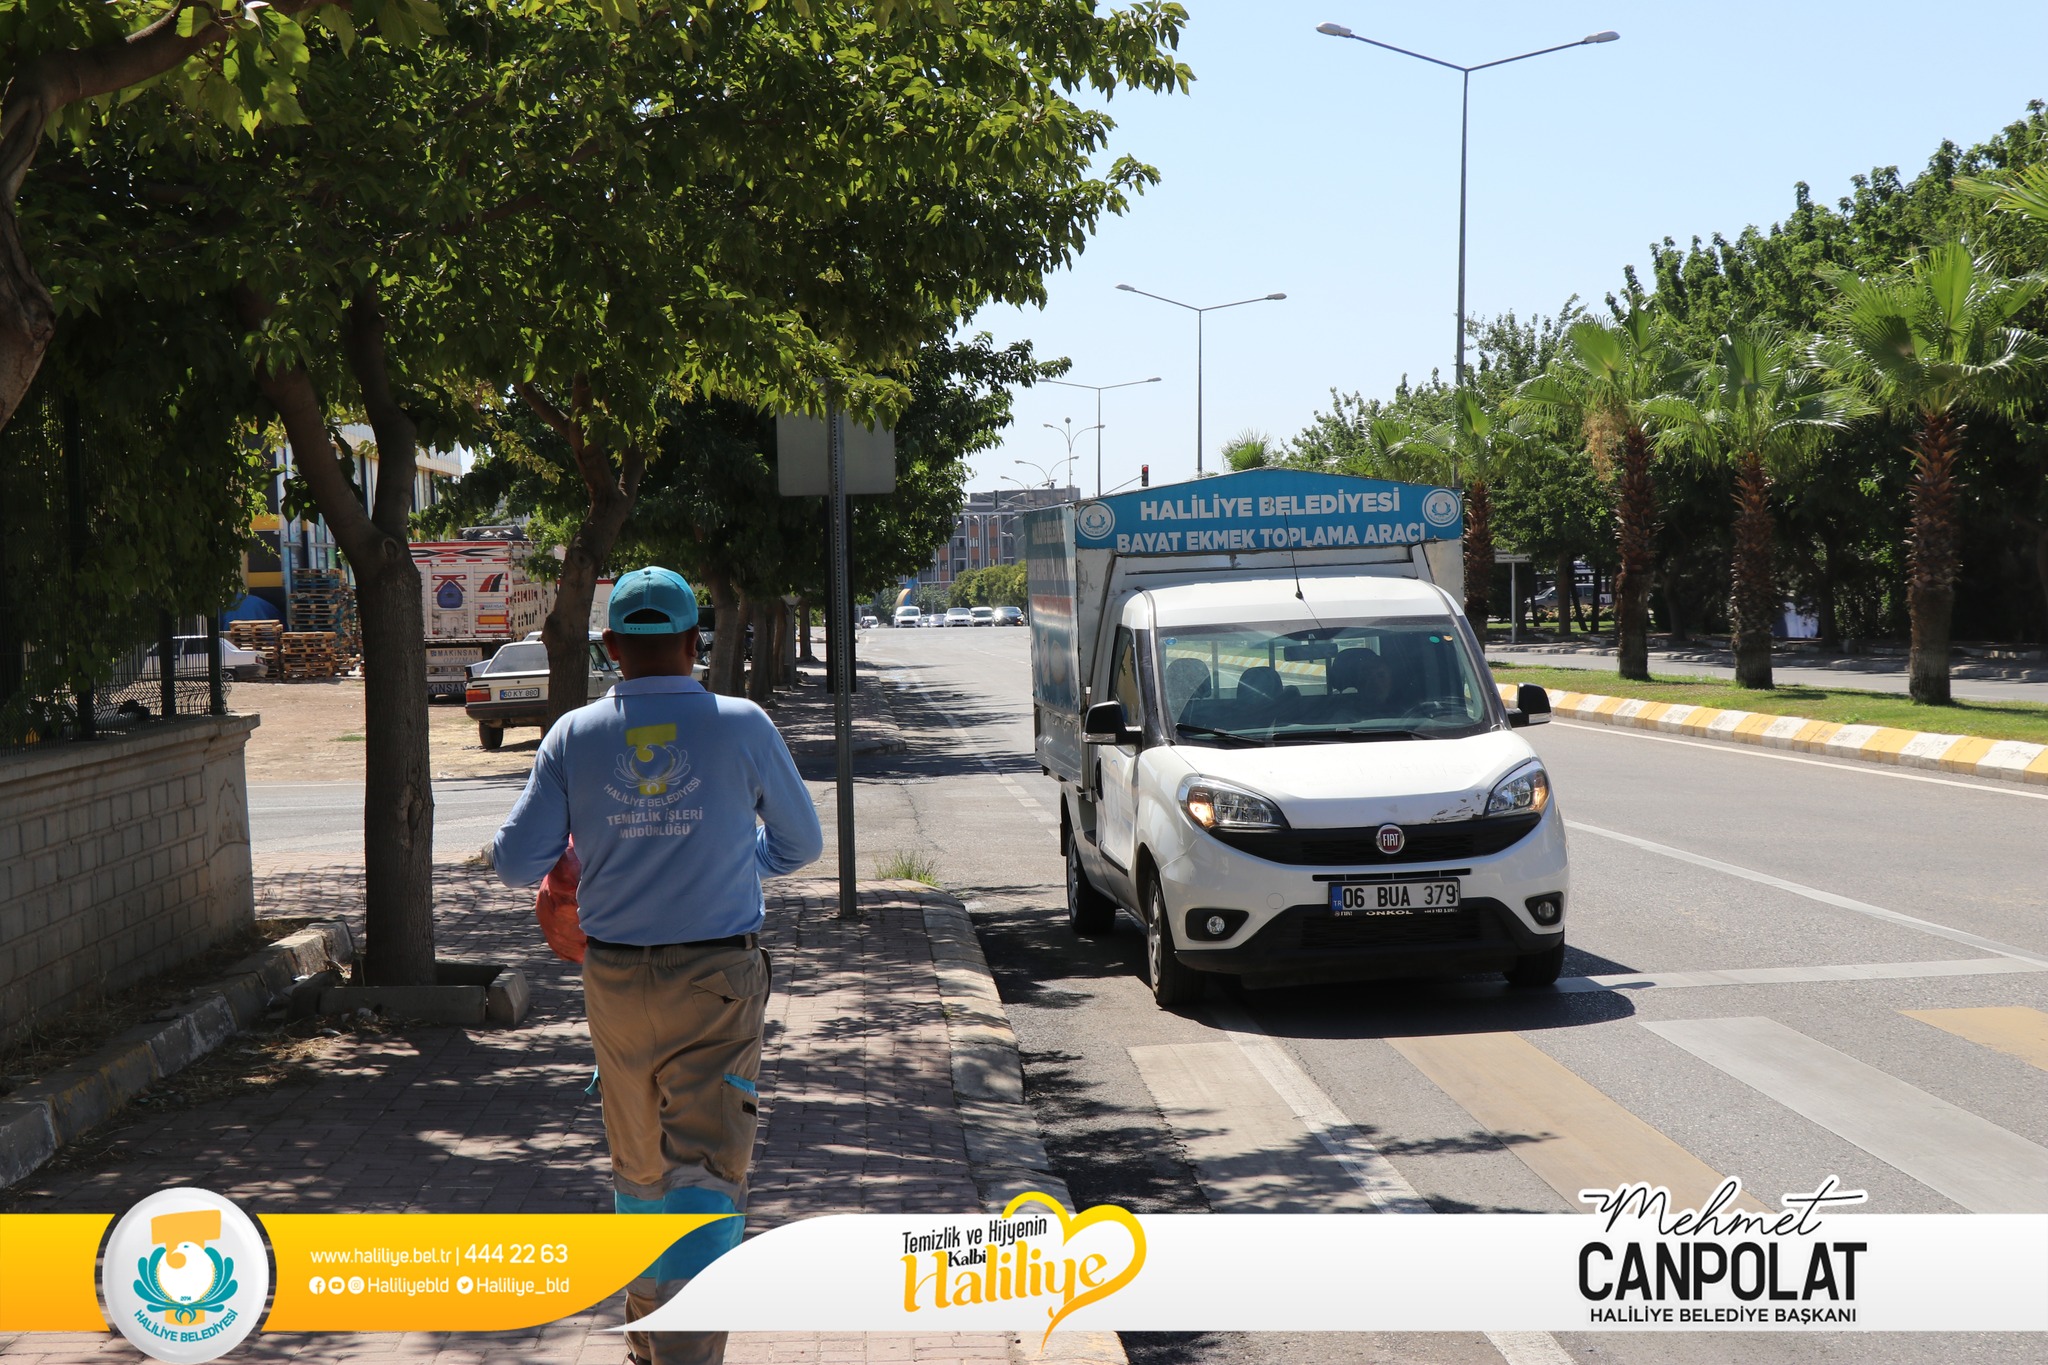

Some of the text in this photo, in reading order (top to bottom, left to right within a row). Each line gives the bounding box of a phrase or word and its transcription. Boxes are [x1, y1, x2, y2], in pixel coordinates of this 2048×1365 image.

[1140, 486, 1400, 521] HALİLİYE BELEDİYESİ
[1117, 530, 1184, 553] BAYAT
[1186, 528, 1257, 551] EKMEK
[1260, 525, 1361, 548] TOPLAMA
[1363, 522, 1426, 545] ARACI
[603, 783, 646, 808] HALİLİYE
[606, 806, 703, 827] TEMİZLİK İŞLERİ
[619, 822, 692, 839] MÜDÜRLÜĞÜ
[1382, 833, 1399, 847] FIAT
[1342, 884, 1457, 909] 06 BUA 379
[1366, 909, 1414, 917] ONKOL
